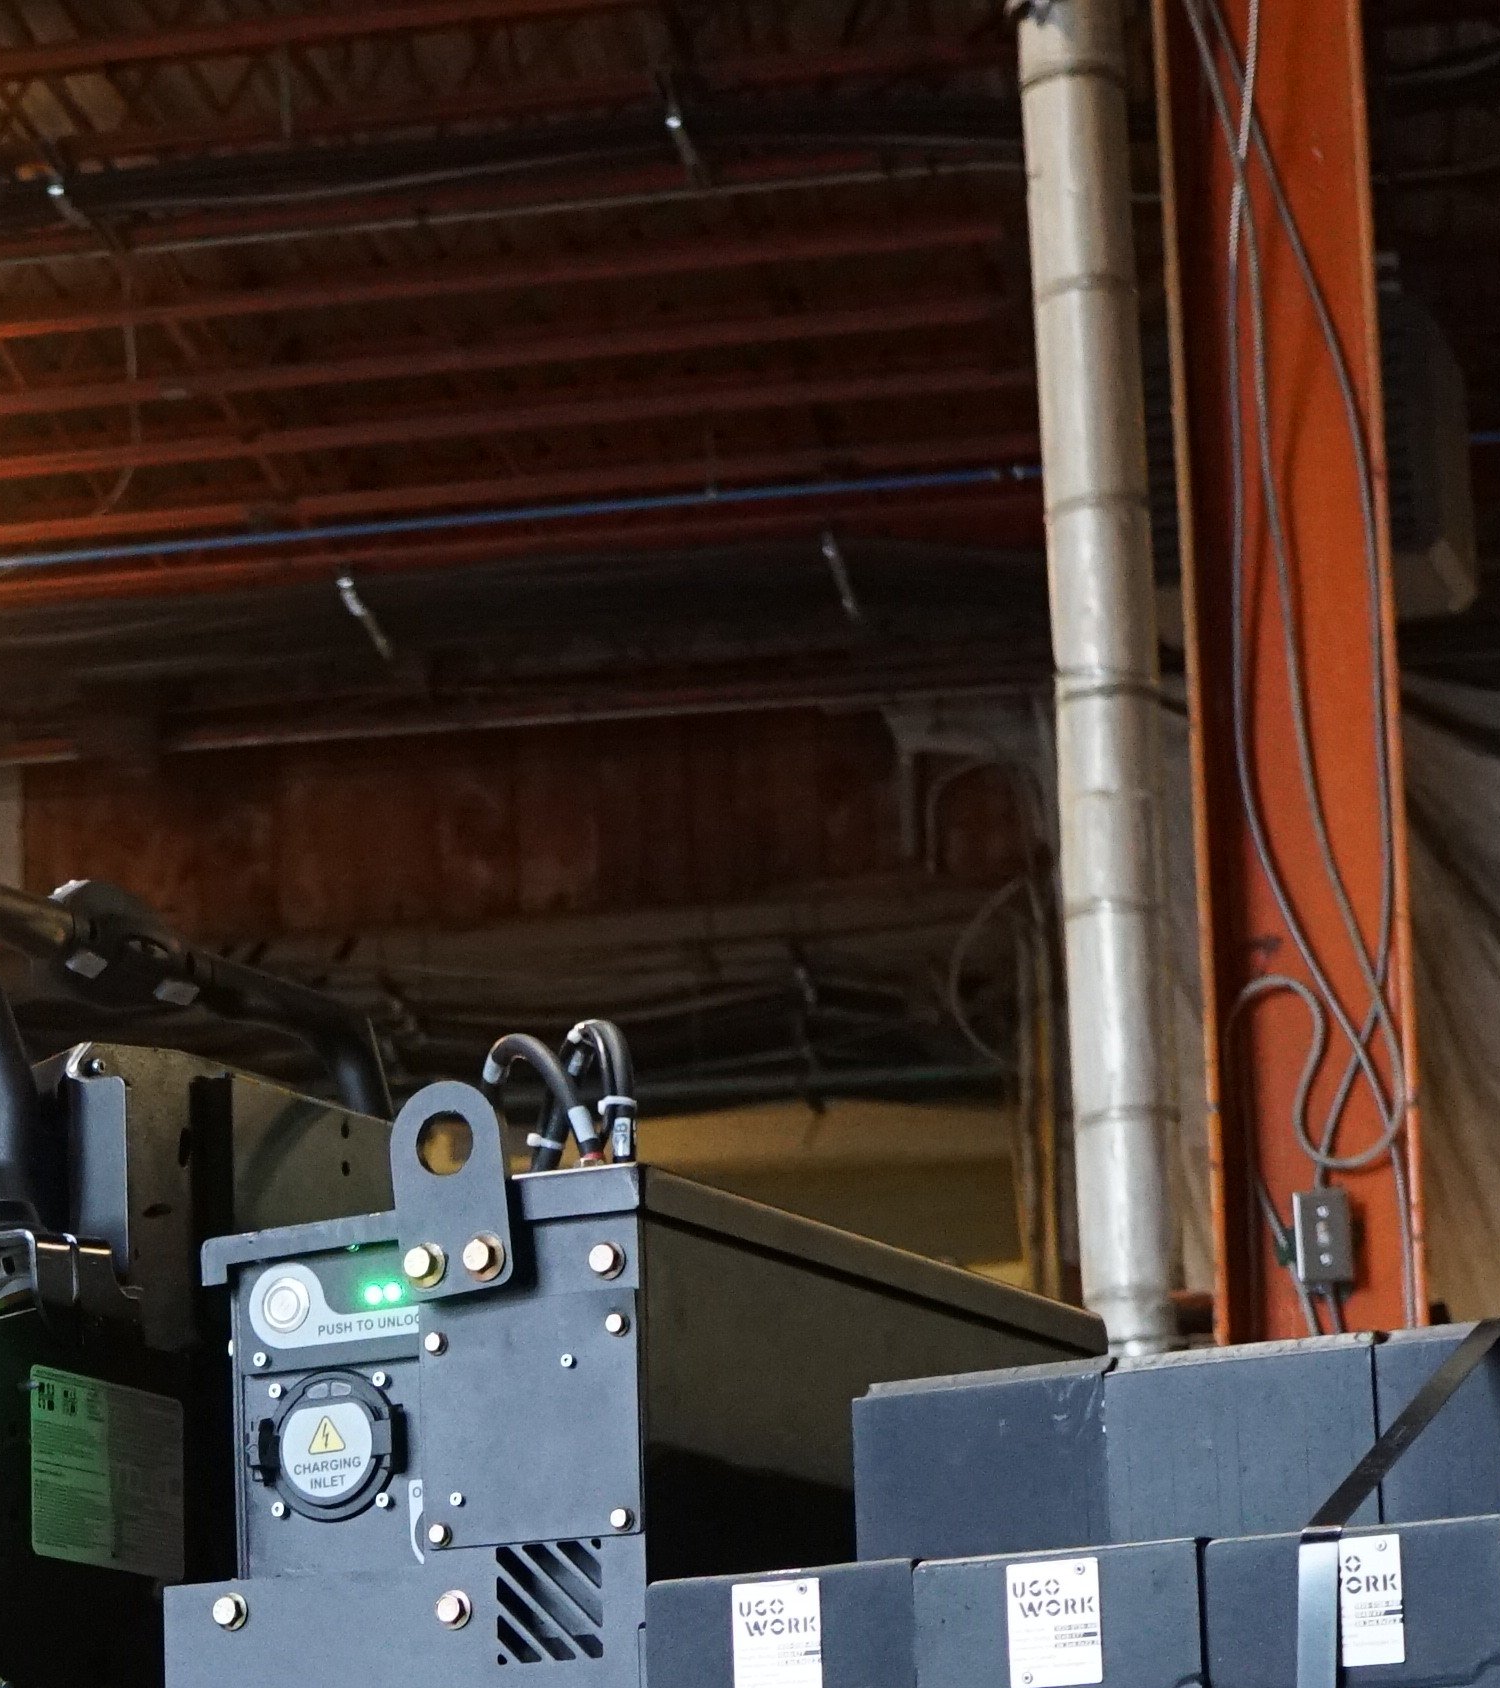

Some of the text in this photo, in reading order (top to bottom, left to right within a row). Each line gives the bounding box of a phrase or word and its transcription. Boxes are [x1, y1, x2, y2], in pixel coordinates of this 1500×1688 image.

[318, 1313, 419, 1336] PUSH TO UNLOC
[294, 1456, 361, 1475] CHARGING
[310, 1474, 346, 1489] INLET
[1012, 1579, 1060, 1598] UGO
[1346, 1573, 1397, 1594] ORK
[739, 1599, 784, 1617] UGO
[1019, 1596, 1094, 1618] WORK
[745, 1616, 816, 1636] WORK
